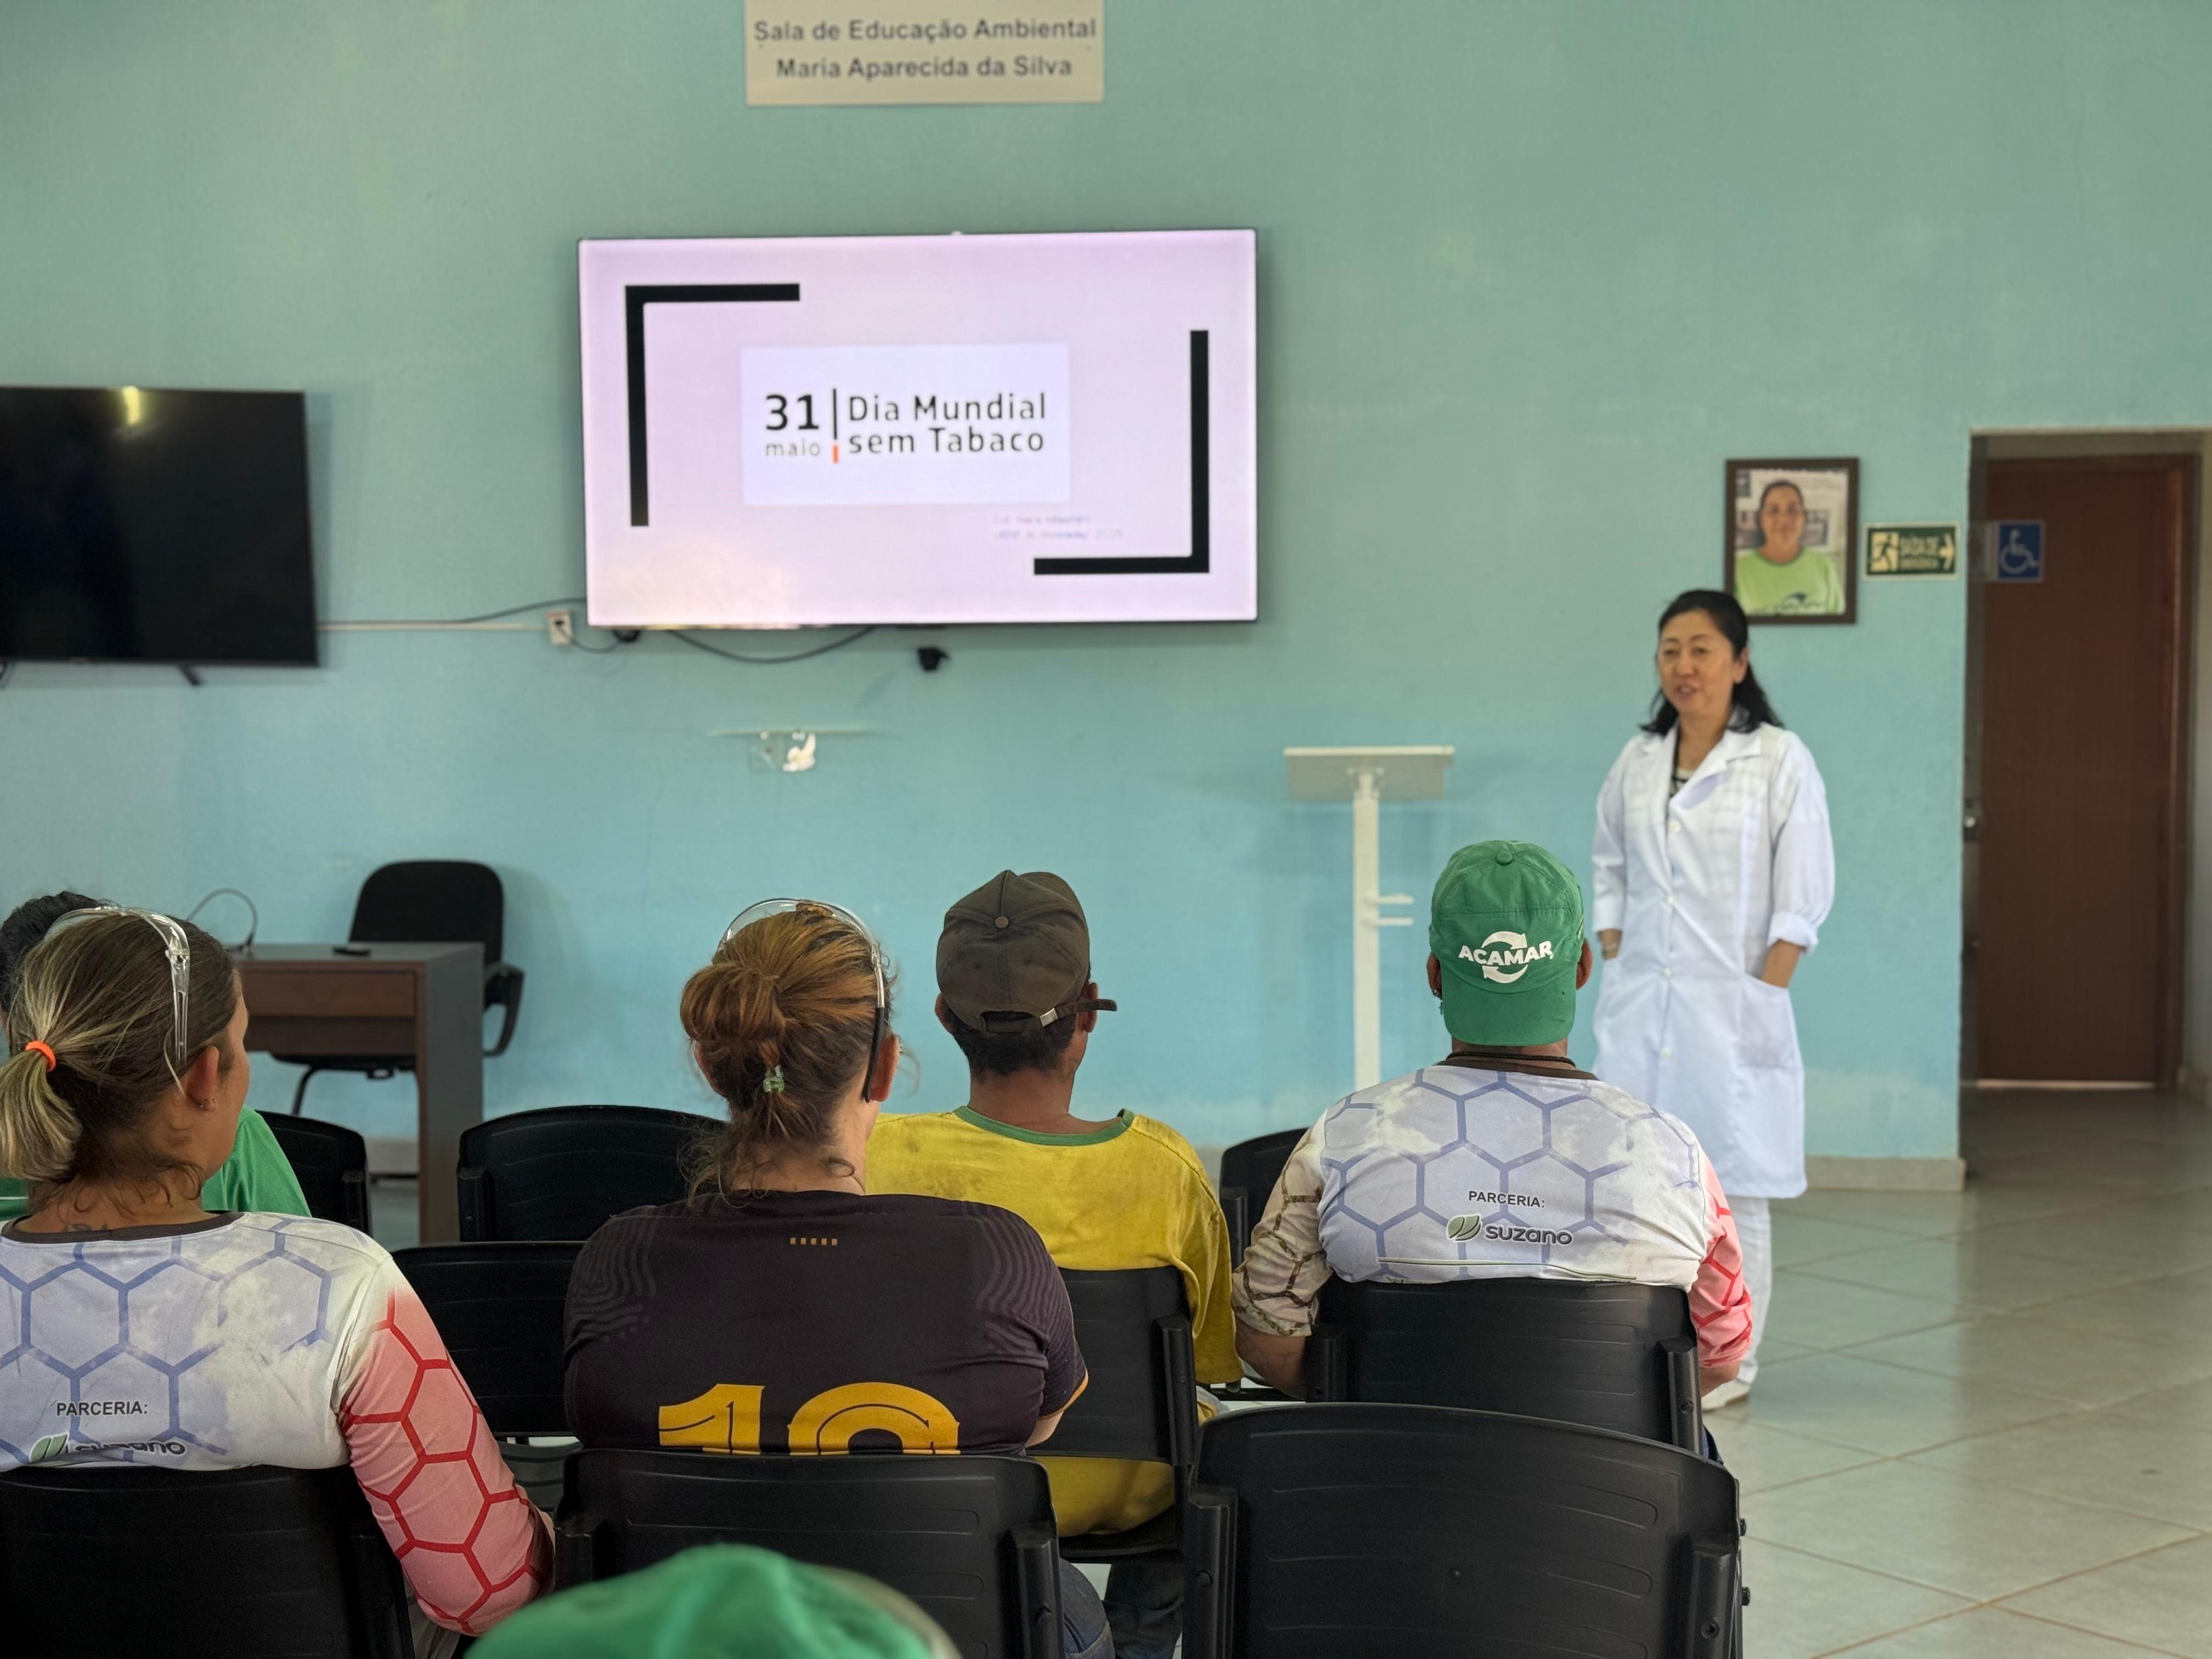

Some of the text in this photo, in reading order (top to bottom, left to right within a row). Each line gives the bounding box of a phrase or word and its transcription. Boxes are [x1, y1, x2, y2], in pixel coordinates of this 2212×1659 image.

[754, 18, 1096, 43] Sala de Educação Ambiental
[776, 54, 1073, 82] Maria Aparecida da Silva
[765, 394, 819, 431] 31
[849, 392, 1045, 421] Dia Mundial
[765, 439, 821, 457] maio
[849, 426, 1043, 453] sem Tabaco
[1458, 940, 1553, 966] ACAMAR
[1468, 1190, 1545, 1207] PARCERIA:
[57, 1401, 148, 1416] PARCERIA:
